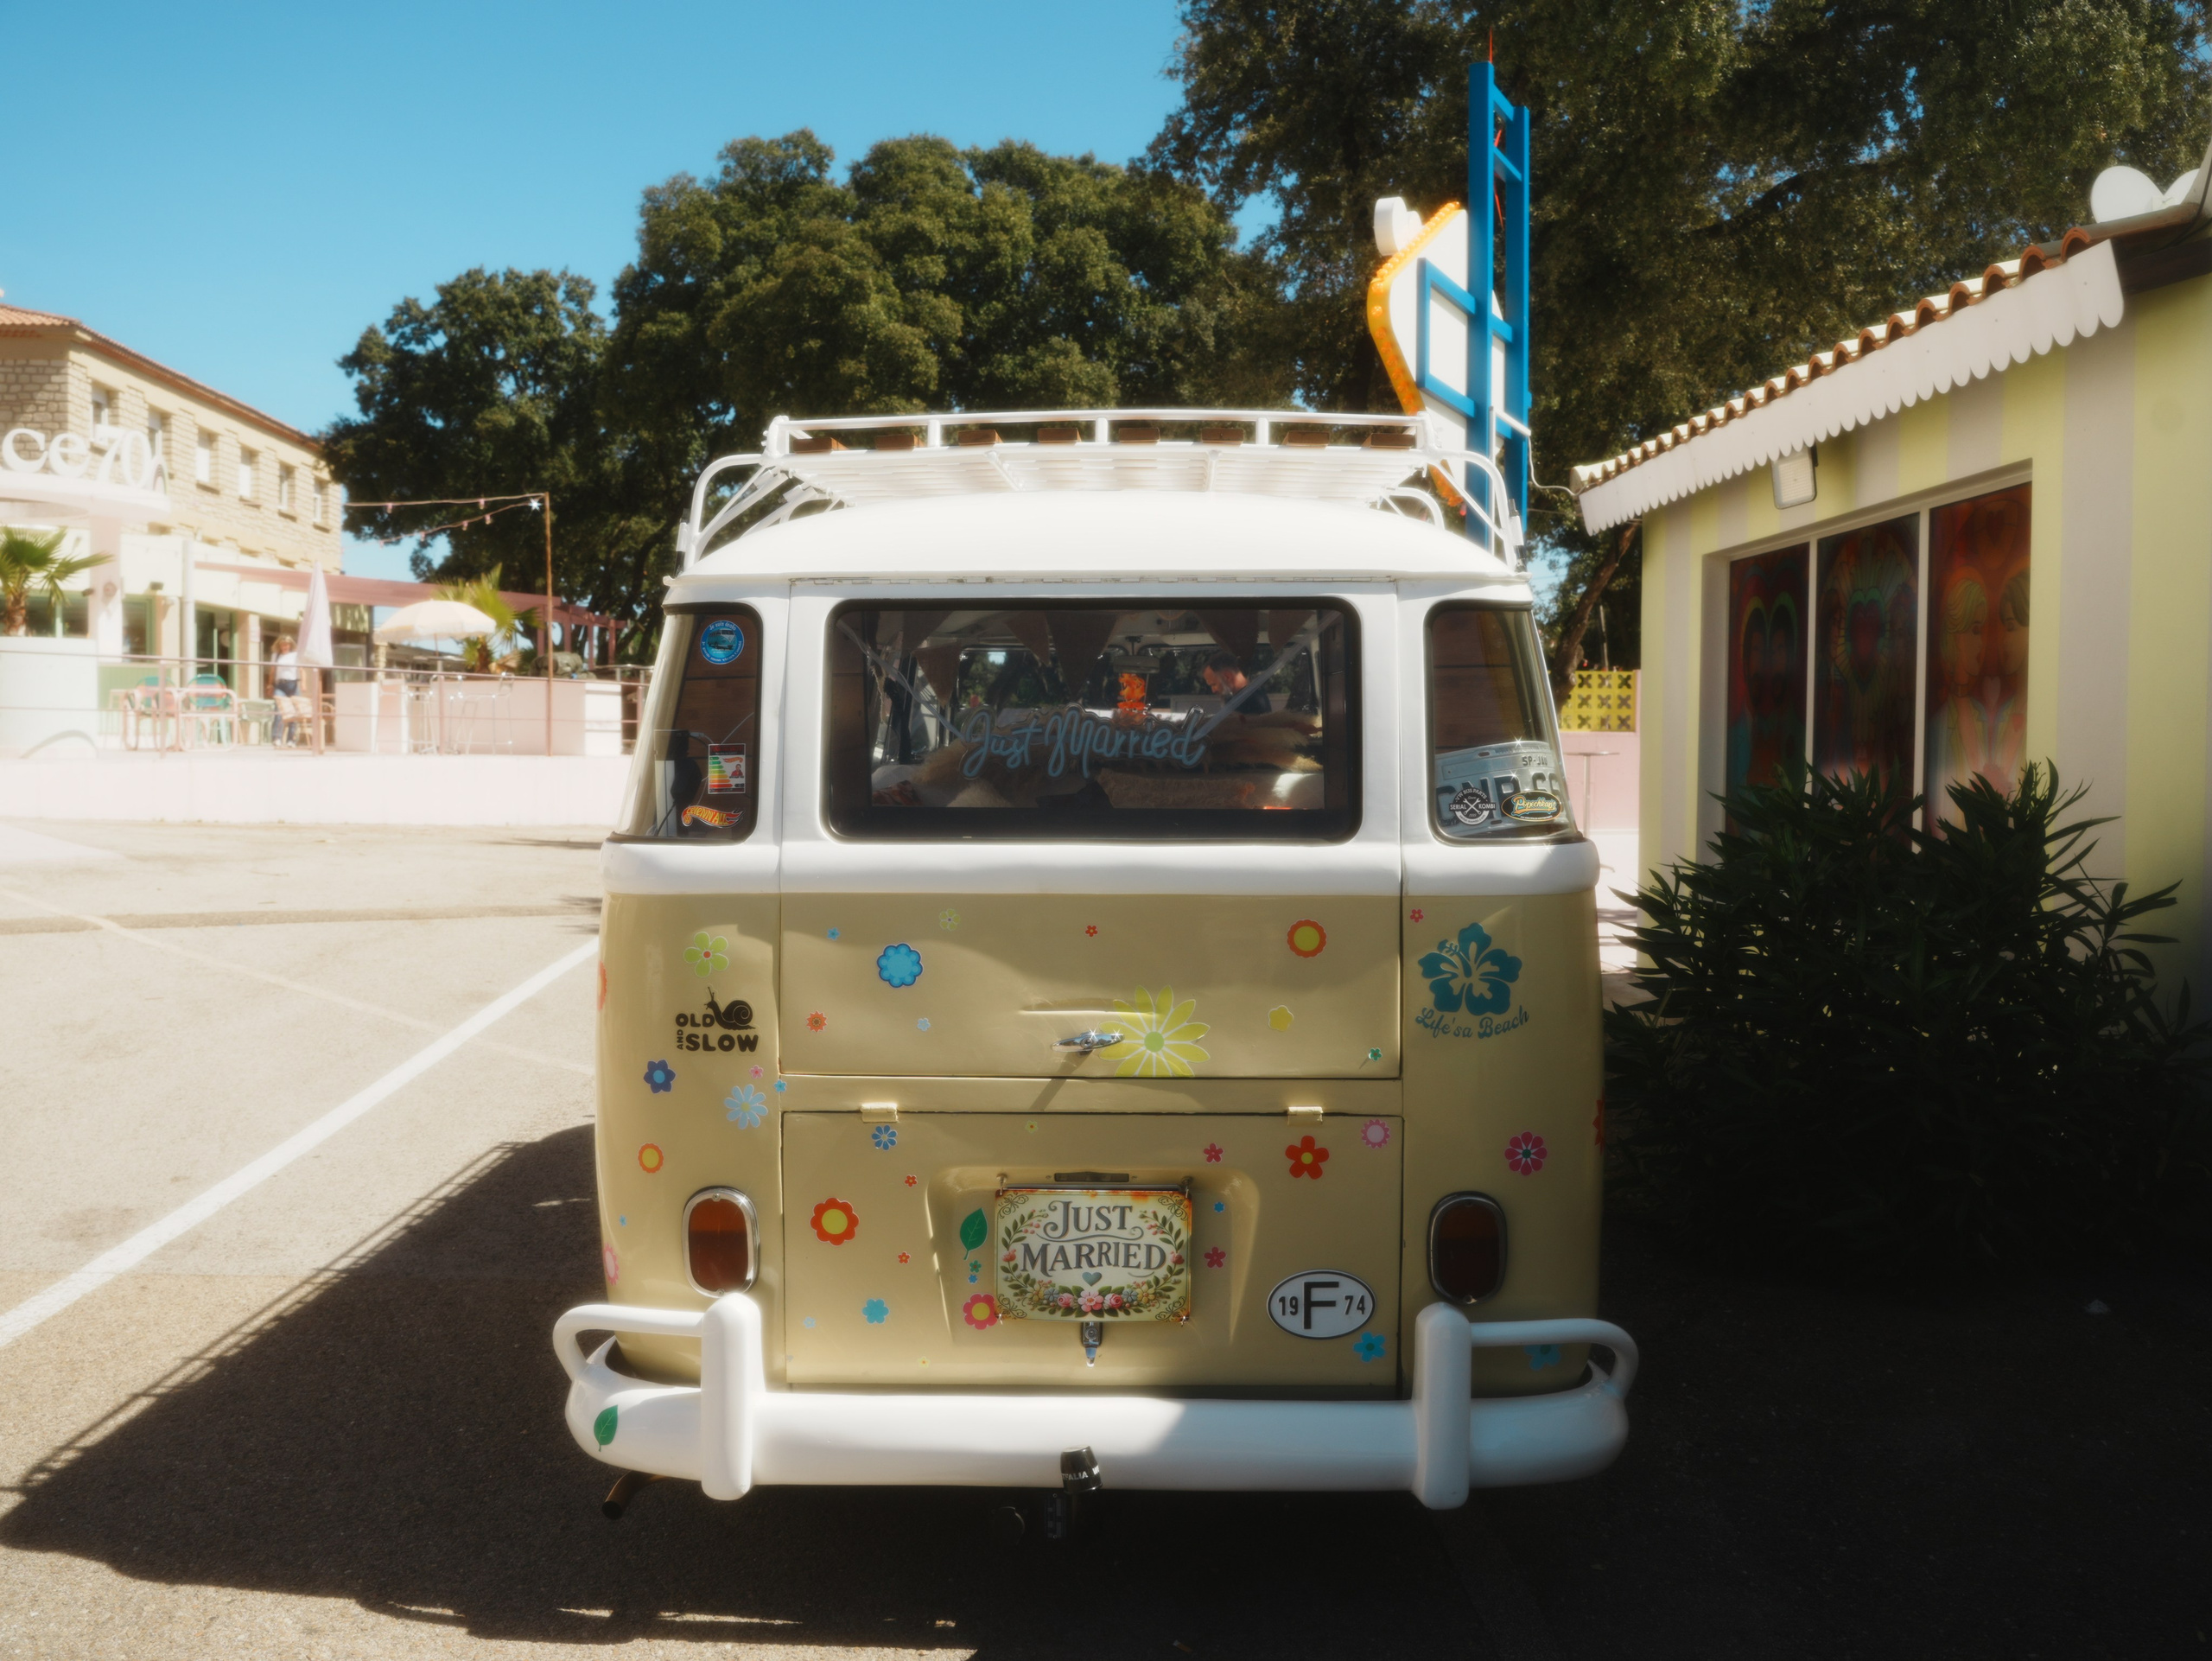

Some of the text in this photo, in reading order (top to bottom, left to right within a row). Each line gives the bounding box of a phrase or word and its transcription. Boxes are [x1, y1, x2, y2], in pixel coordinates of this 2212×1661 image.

[962, 709, 1208, 780] Just Married
[1454, 792, 1465, 800] VW
[1472, 788, 1488, 799] PARTS
[675, 1013, 715, 1028] OLD
[1478, 1004, 1530, 1040] Beach
[685, 1033, 759, 1053] SLOW
[1042, 1200, 1134, 1239] JUST
[1020, 1241, 1167, 1277] MARRIED
[1278, 1281, 1366, 1330] 19 F 74
